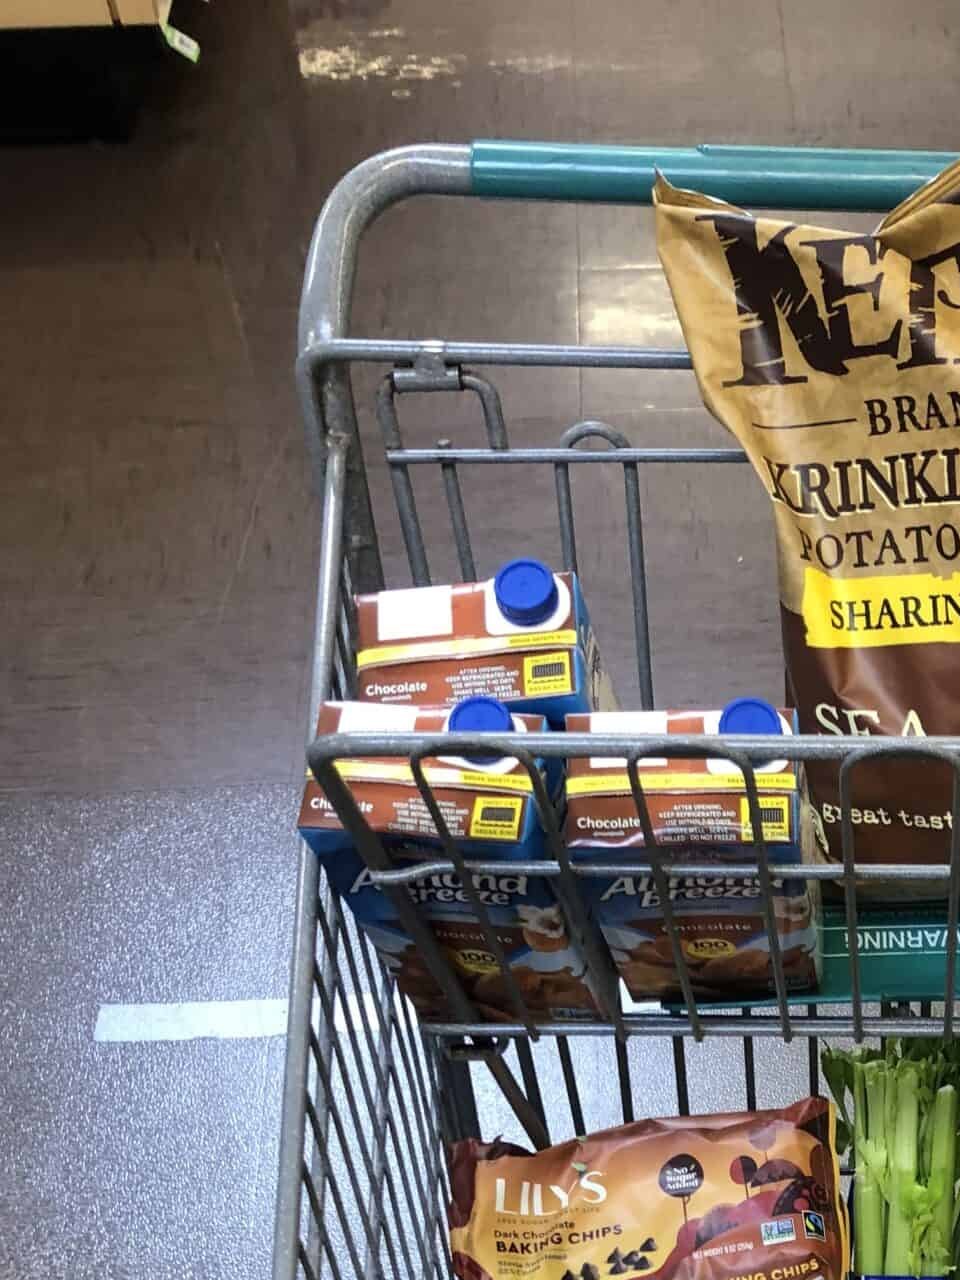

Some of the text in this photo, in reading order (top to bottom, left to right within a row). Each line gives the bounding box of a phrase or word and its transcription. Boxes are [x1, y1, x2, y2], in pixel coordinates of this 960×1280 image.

[800, 523, 960, 571] POTATO
[366, 681, 428, 697] Chocolate
[577, 816, 641, 830] Chocolate
[496, 1224, 623, 1255] BAKING CHIPS
[771, 1258, 820, 1280] CHIPS
